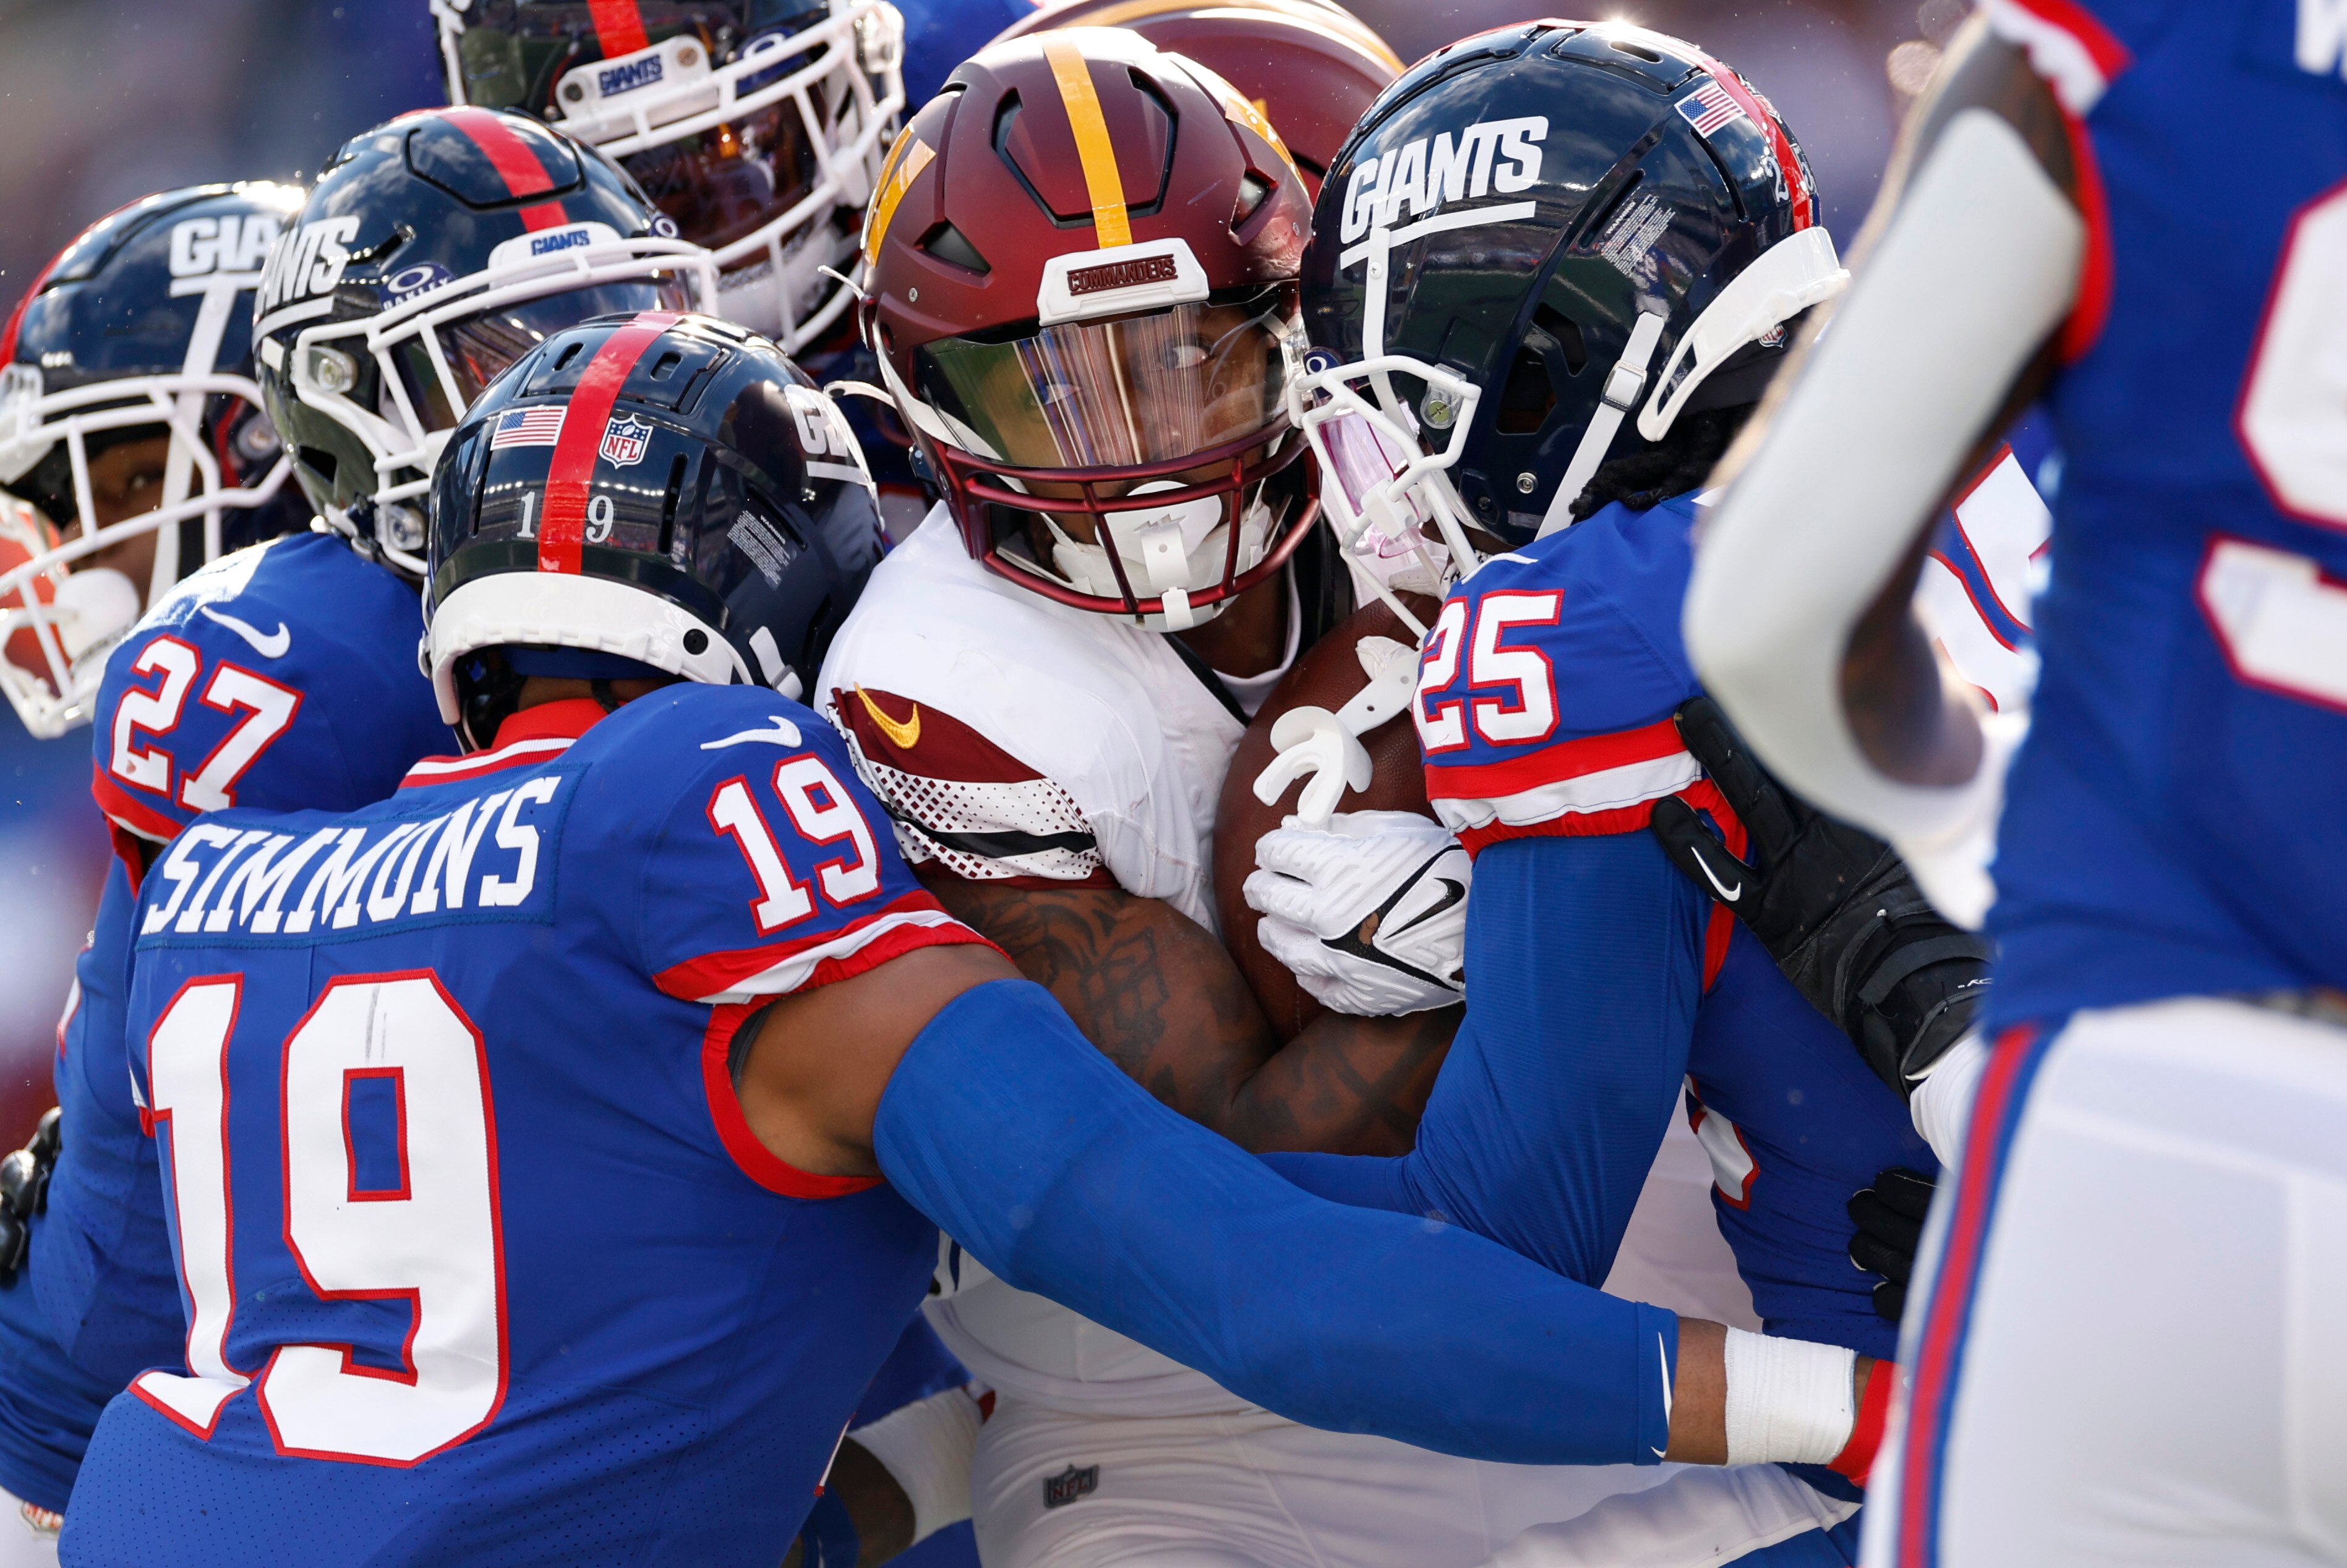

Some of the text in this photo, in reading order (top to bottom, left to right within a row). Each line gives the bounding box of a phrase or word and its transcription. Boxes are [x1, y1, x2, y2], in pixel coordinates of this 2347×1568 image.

[599, 54, 662, 91] GIANTS
[1340, 116, 1549, 244] GIANTS
[169, 215, 278, 278] GIA
[531, 229, 590, 256] GIANTS
[1605, 201, 1636, 234] WARNING
[253, 215, 361, 317] ANTS
[1067, 257, 1177, 292] COMMANDERS
[605, 435, 638, 459] NFL
[760, 514, 786, 545] WARNING
[1411, 589, 1565, 756] 25
[109, 633, 304, 813] 27
[140, 776, 562, 935] SIMMONS
[706, 751, 882, 937] 19
[128, 967, 510, 1468] 19
[1052, 1477, 1090, 1499] NFL
